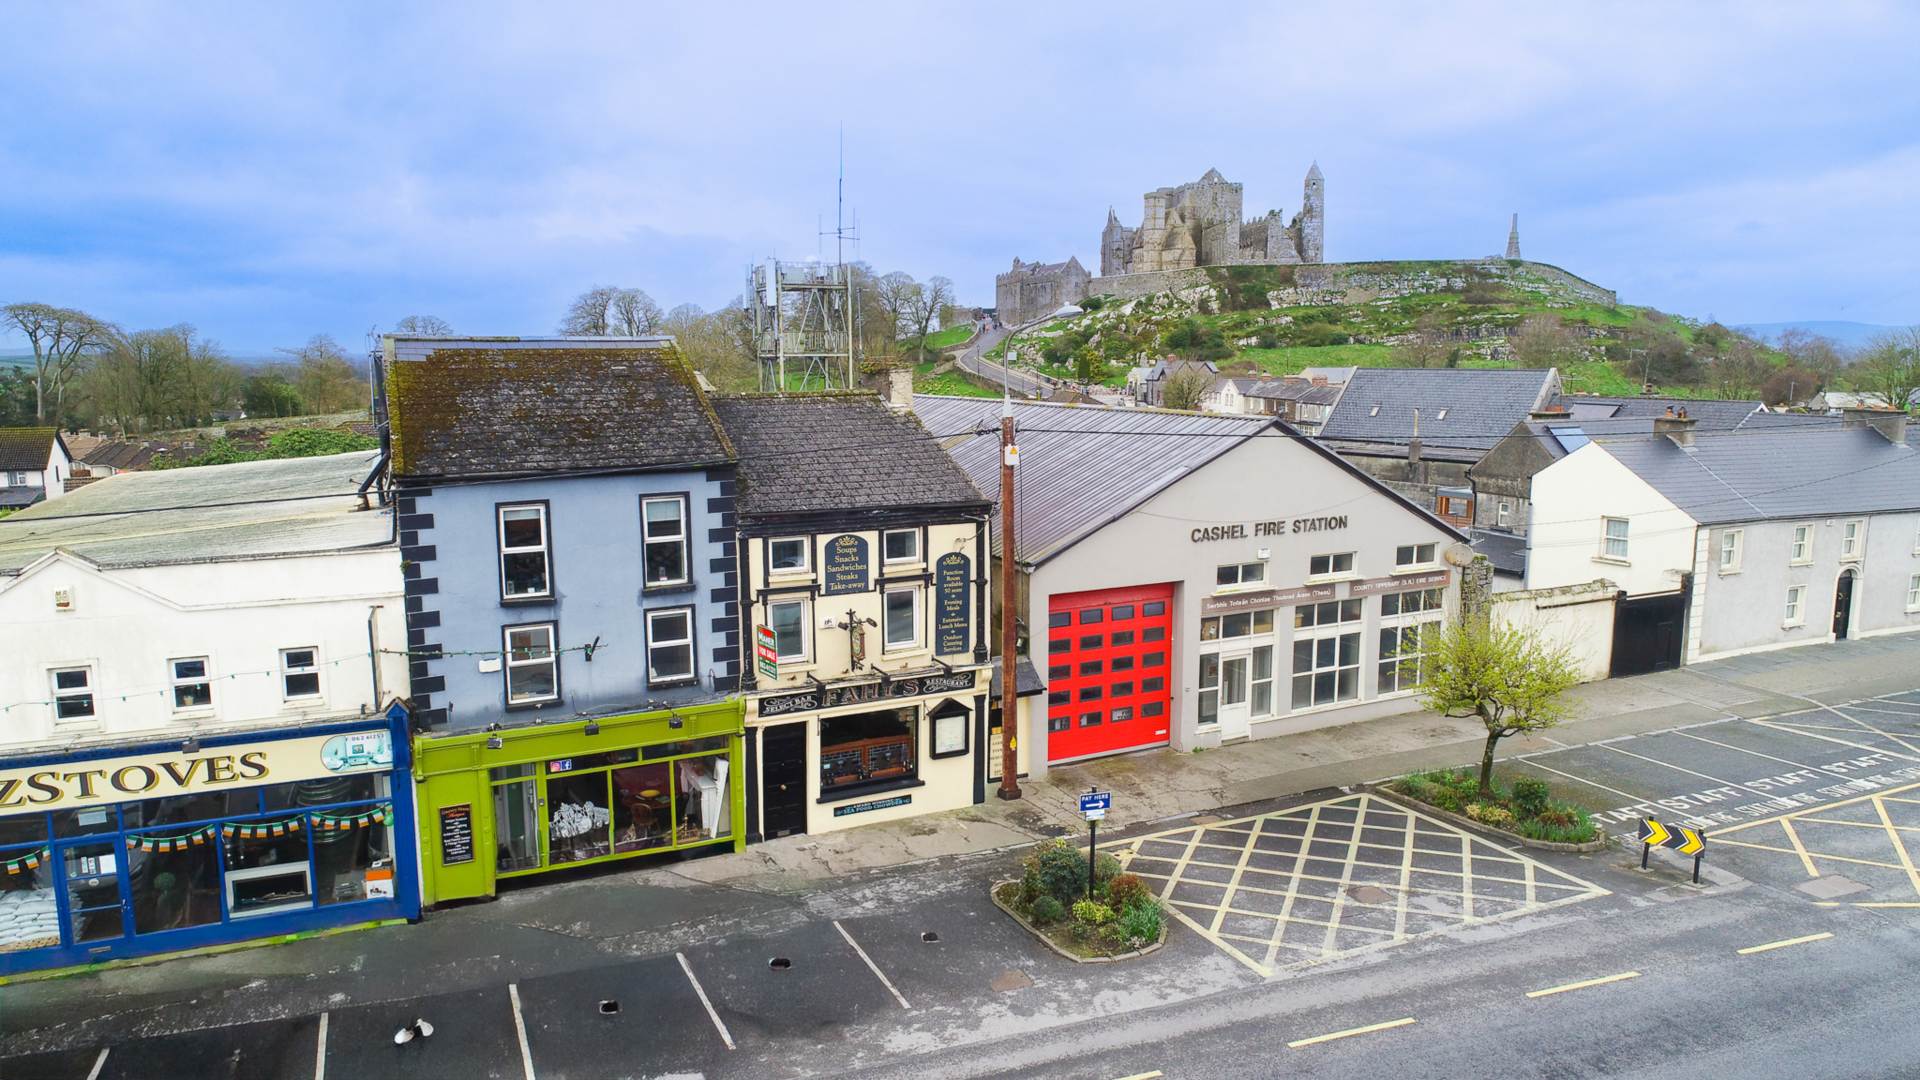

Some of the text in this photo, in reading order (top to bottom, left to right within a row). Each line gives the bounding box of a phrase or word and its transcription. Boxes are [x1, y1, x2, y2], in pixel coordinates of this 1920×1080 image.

[1191, 515, 1348, 543] CASHEL FIRE STATION
[836, 546, 857, 555] Soups
[834, 554, 859, 563] Snacks
[827, 563, 867, 573] Sandwiches
[836, 572, 858, 581] Steaks
[1353, 584, 1374, 592] COUNTY
[1375, 580, 1400, 588] TIPPERARY
[765, 701, 794, 713] SELECT
[1820, 753, 1894, 773] STAFF
[1744, 769, 1820, 791] STAFF
[1657, 786, 1742, 810] STAFF
